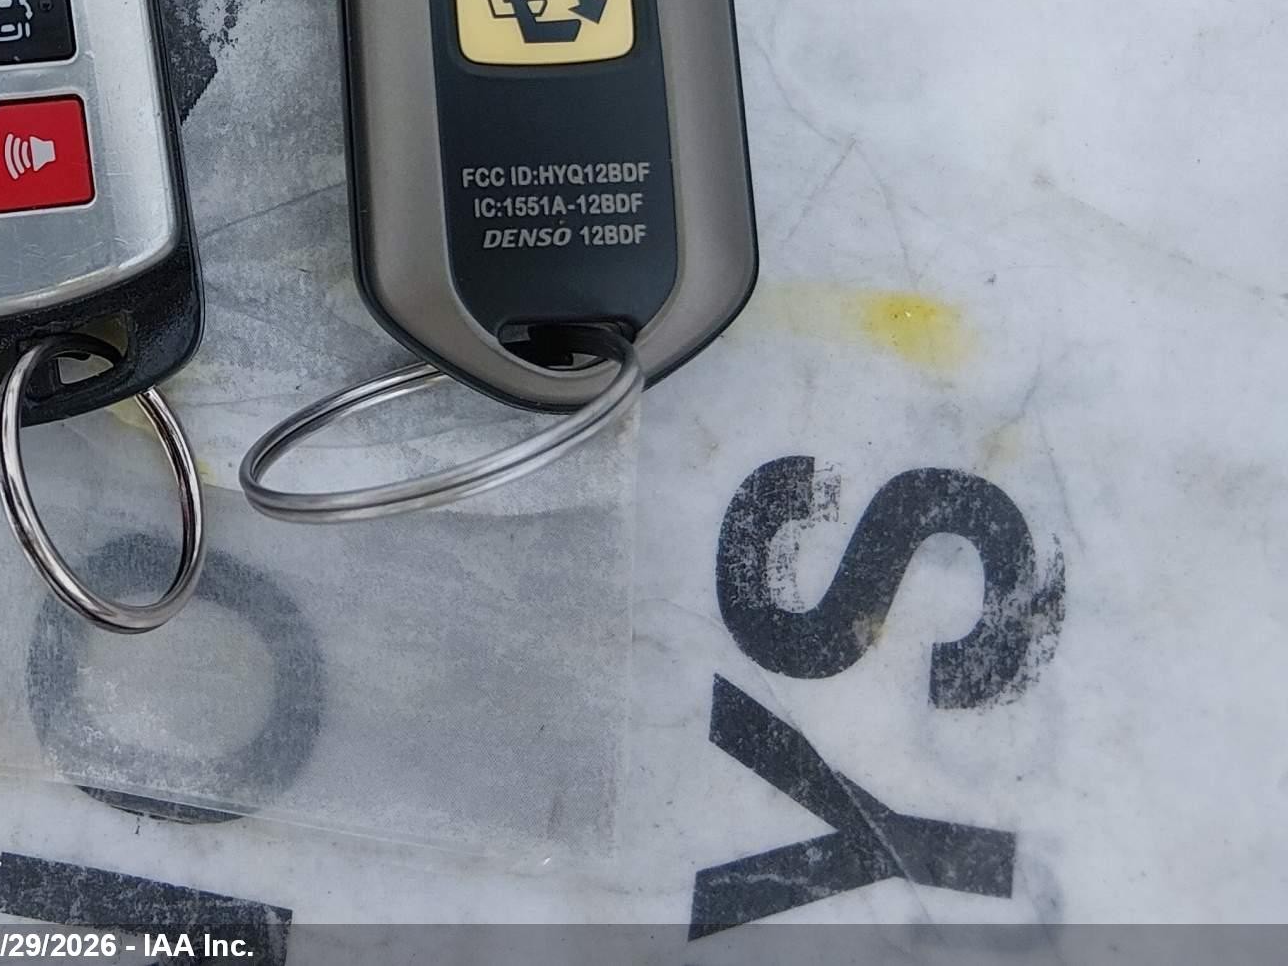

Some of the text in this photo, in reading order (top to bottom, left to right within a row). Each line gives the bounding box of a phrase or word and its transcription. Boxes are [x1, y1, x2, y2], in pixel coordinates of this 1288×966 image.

[461, 162, 651, 188] FCC ID:HYQ12BDF
[473, 192, 644, 218] IC:1551A-12BDF
[482, 224, 647, 249] DENSO 12BDF
